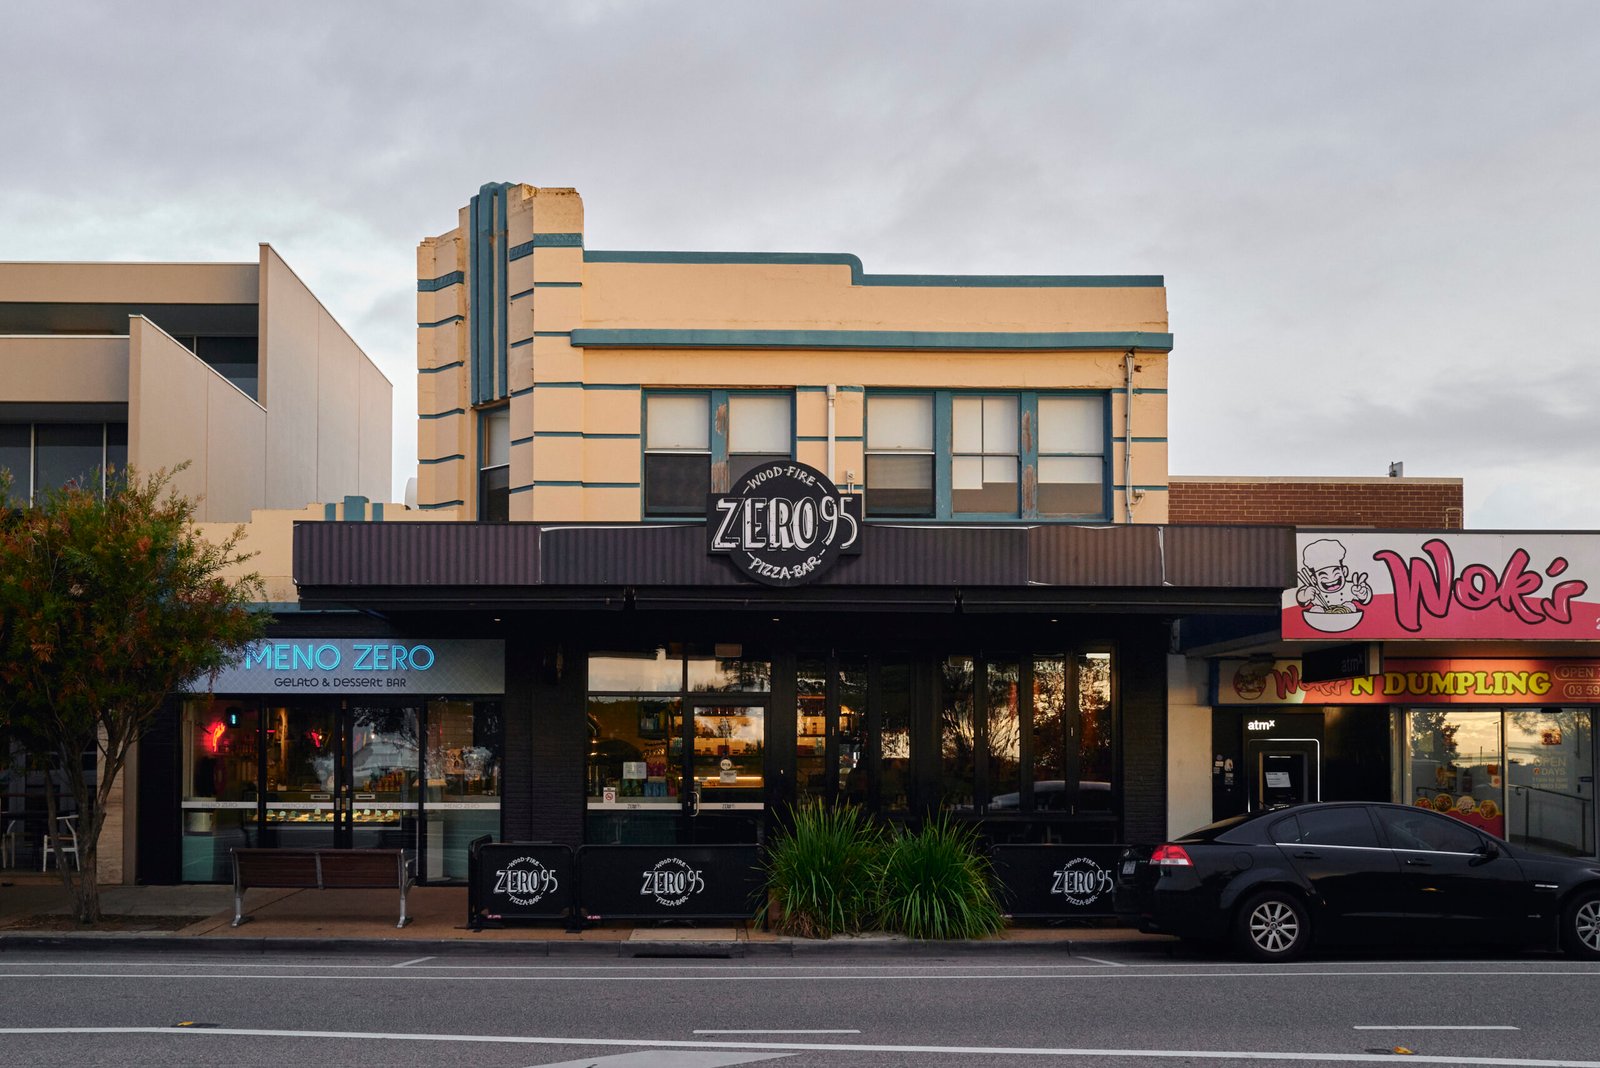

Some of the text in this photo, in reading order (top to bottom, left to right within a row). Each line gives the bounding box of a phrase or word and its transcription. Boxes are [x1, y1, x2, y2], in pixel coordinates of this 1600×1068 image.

[747, 466, 816, 490] WOOD-FIRE
[748, 556, 822, 580] PIZZA-BAR
[1373, 538, 1588, 633] Wok's
[245, 644, 435, 670] MENO ZERO
[322, 678, 331, 687] &
[386, 678, 407, 688] BAR
[1352, 675, 1375, 696] N
[1383, 671, 1552, 696] DUMPLING
[1560, 667, 1594, 678] OPEN
[1568, 684, 1583, 696] 03
